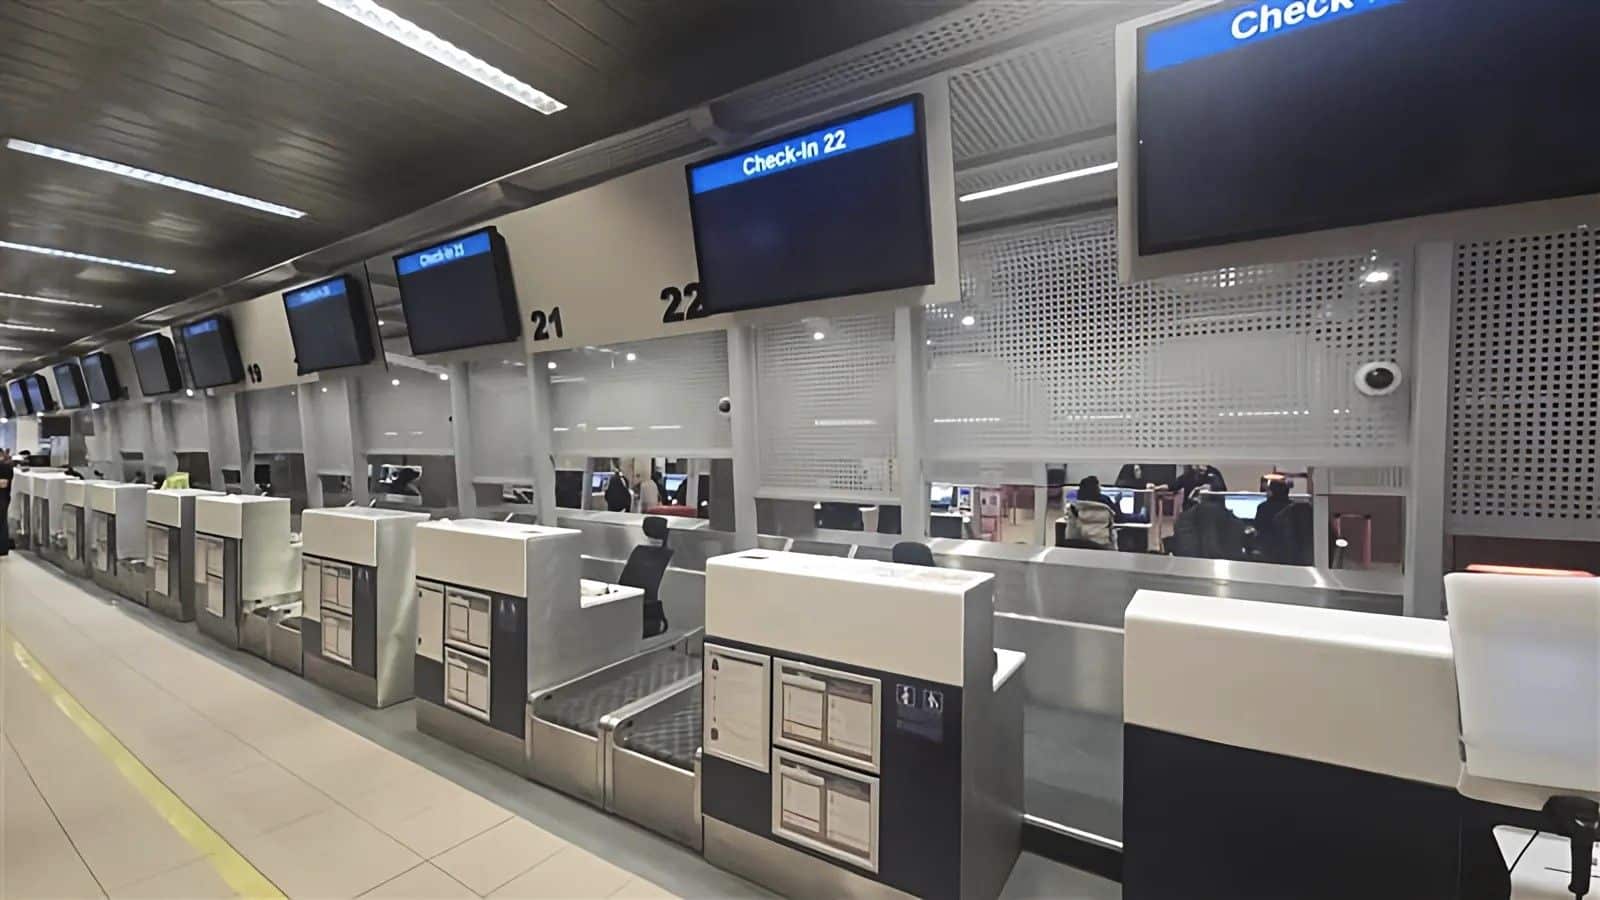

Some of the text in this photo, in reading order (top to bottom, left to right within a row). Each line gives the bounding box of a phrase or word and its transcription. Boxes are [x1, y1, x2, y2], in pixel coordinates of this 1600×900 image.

[742, 129, 847, 176] Check-In 22
[660, 282, 703, 324] 22
[531, 306, 563, 341] 21
[247, 363, 262, 384] 19
